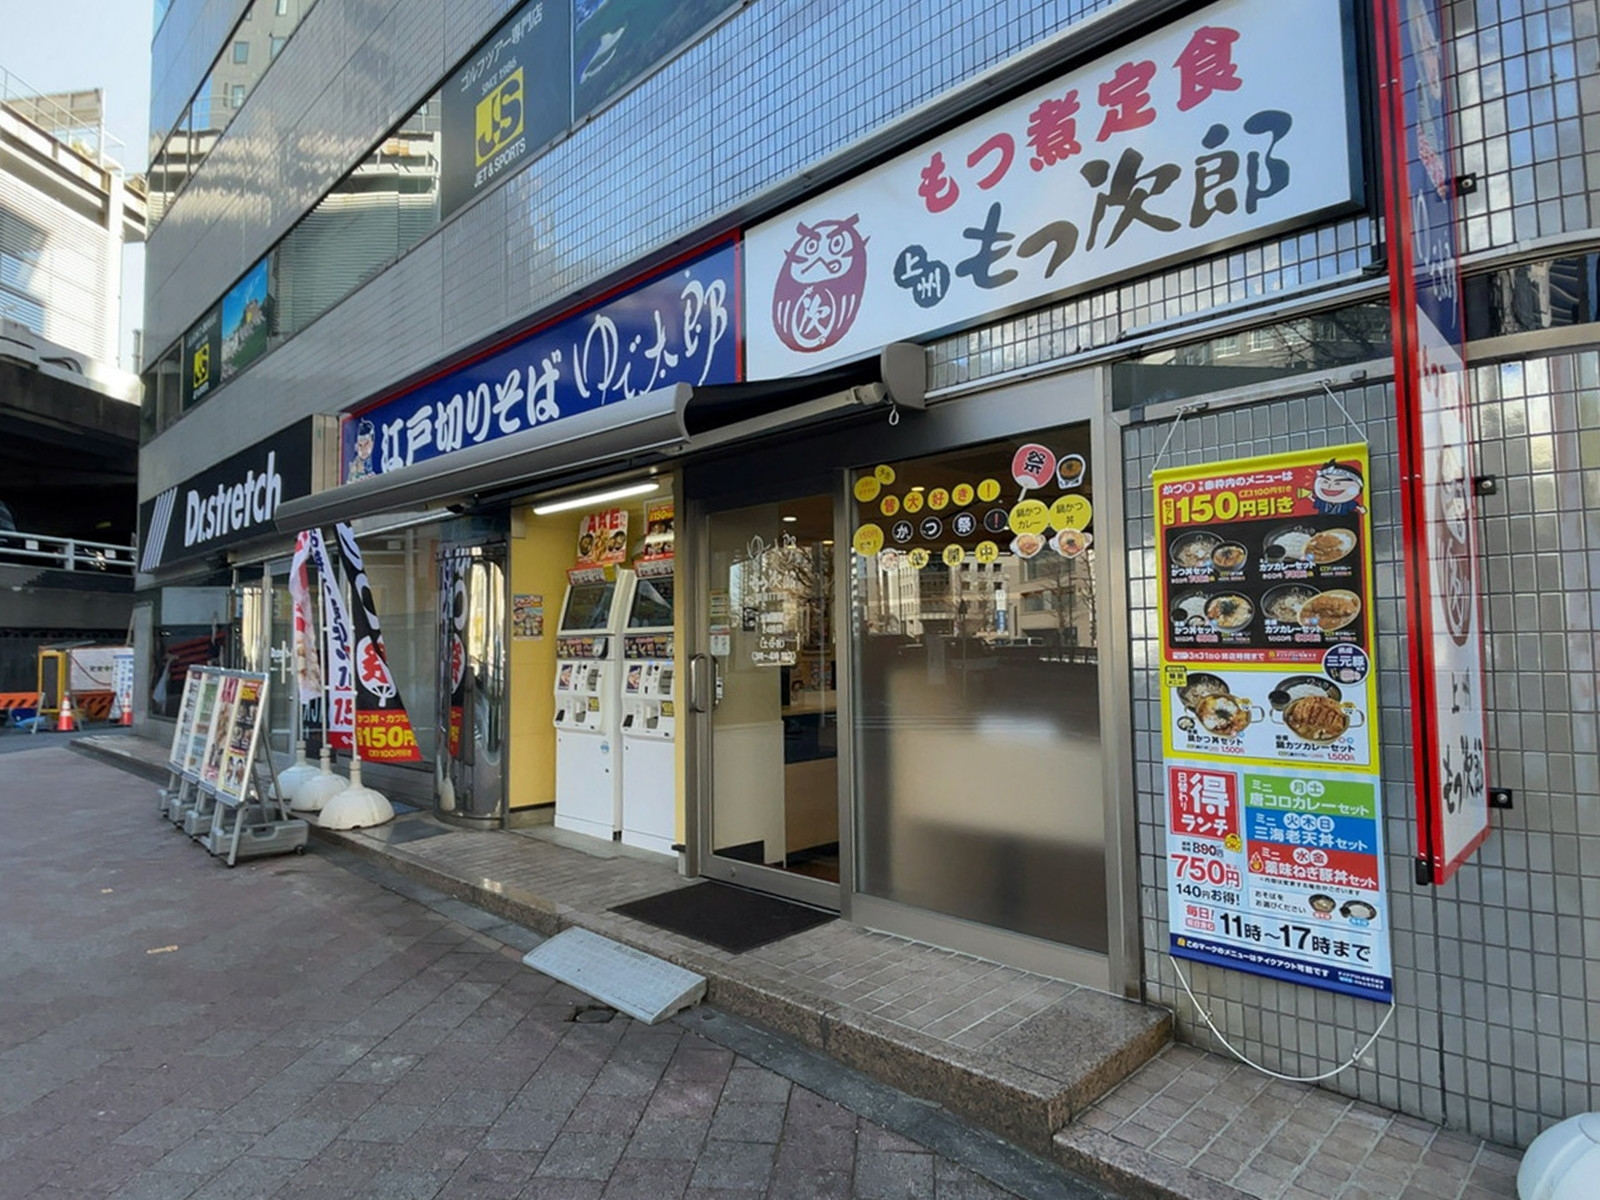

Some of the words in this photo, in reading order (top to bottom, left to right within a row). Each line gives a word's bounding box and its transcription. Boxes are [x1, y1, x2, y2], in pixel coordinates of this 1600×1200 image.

[461, 2, 543, 92] ゴルフツアー専門店
[481, 77, 498, 96] SINCE
[918, 26, 1242, 213] もつ煮定食
[474, 165, 488, 188] JET
[494, 137, 526, 173] SPORTS
[955, 110, 1292, 289] もつ次郎
[381, 350, 563, 474] 江戸切りそば
[184, 451, 283, 547] Dr.stretch
[1056, 502, 1084, 514] 鍋かつ
[1177, 491, 1294, 524] 150円引き
[1016, 506, 1042, 519] 鍋かつ
[1017, 520, 1041, 530] カレー
[1259, 561, 1316, 572] カツカレーセット
[1264, 624, 1325, 634] カツカレーセット
[1187, 734, 1244, 746] 鍋かつ丼セット
[1275, 740, 1355, 753] 鍋カツカレーセット
[1189, 773, 1230, 817] 得
[1252, 780, 1273, 793] ミニ
[1250, 792, 1369, 816] 唐コロカレーセット
[1181, 813, 1229, 836] ランチ
[1256, 813, 1277, 827] ミニ
[1254, 825, 1368, 852] 三海老天丼セット
[1262, 847, 1281, 861] ミニ
[1171, 853, 1241, 889] 750円
[1176, 883, 1241, 907] 140円お得!
[1255, 890, 1284, 902] おそばを
[1186, 904, 1215, 921] 毎日!
[1255, 899, 1307, 914] お選びください
